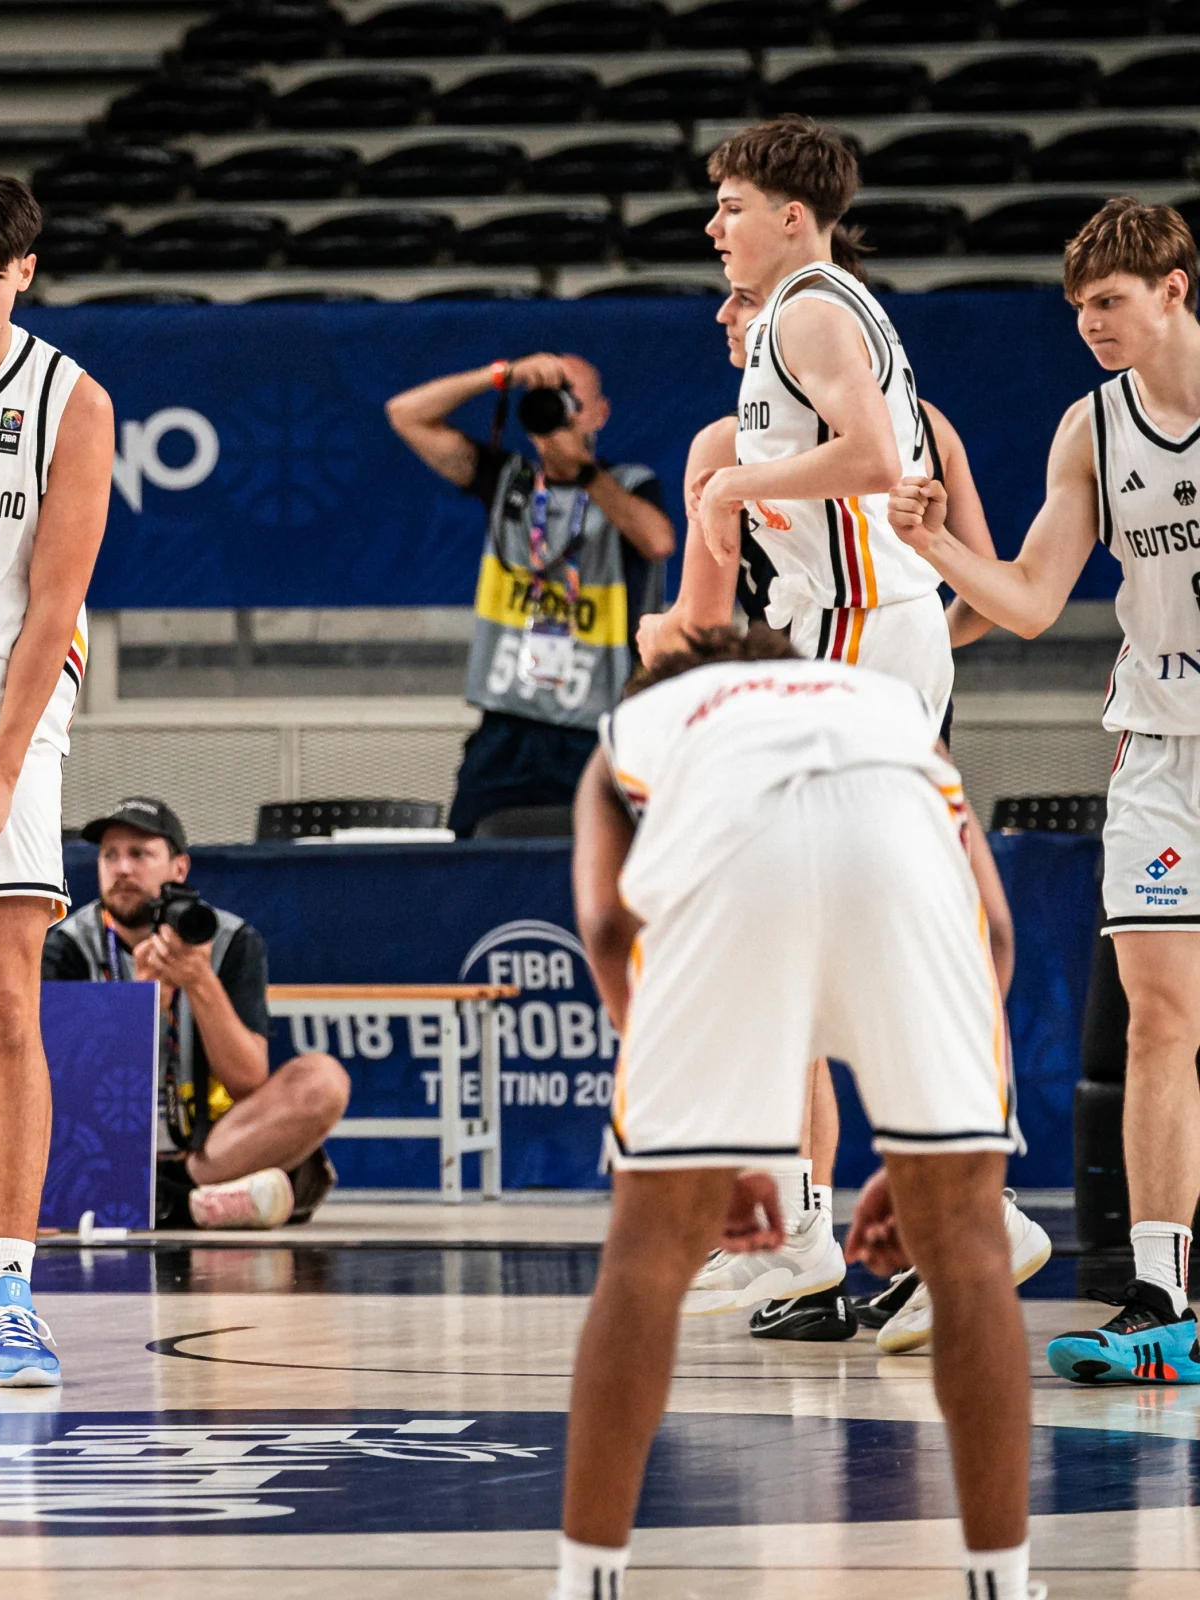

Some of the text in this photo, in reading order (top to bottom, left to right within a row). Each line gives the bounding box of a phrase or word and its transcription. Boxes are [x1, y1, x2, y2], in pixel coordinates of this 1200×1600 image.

[1135, 884, 1189, 896] Domino's
[1146, 895, 1178, 905] Pizza
[488, 951, 575, 991] FIBA
[289, 1012, 394, 1060] U18
[421, 1071, 569, 1107] TETINO
